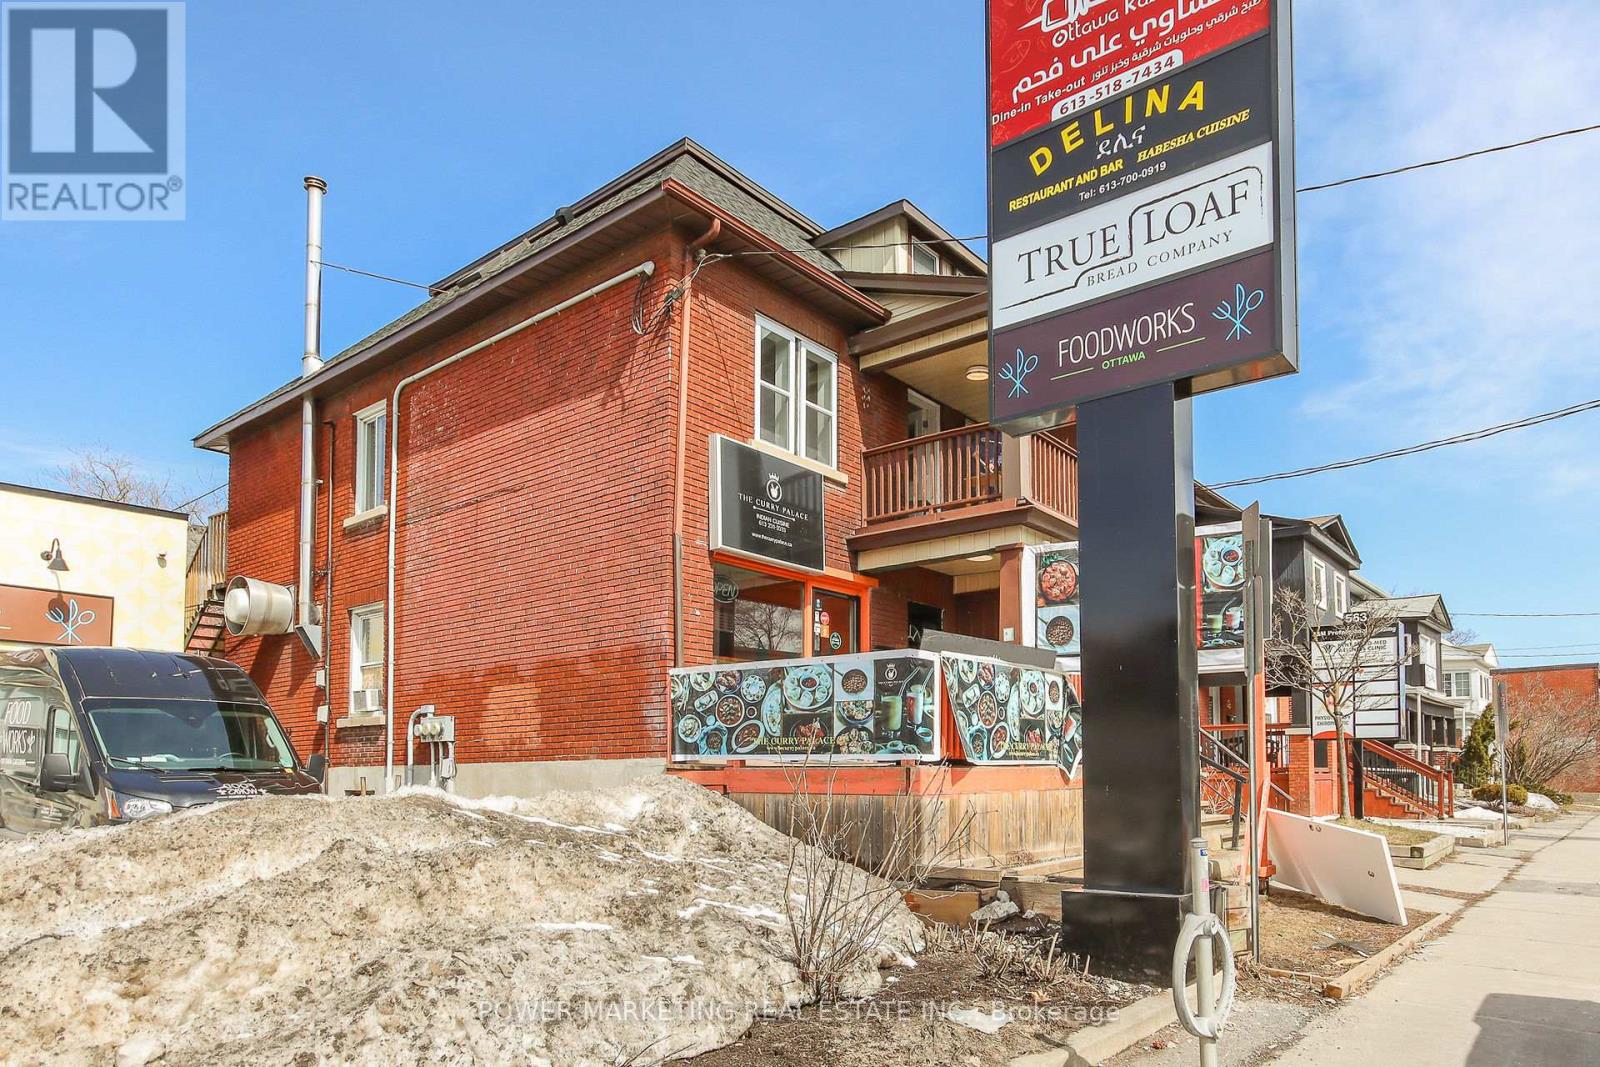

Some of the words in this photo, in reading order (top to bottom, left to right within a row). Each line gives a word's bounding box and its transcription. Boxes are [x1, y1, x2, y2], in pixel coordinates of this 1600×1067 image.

[1052, 8, 1119, 48] Ottawa
[1070, 33, 1122, 68] على
[1012, 56, 1064, 103] فحم
[991, 102, 1032, 126] Dine-in
[1034, 76, 1086, 105] Take-out
[1029, 80, 1206, 176] DELINA
[1008, 177, 1074, 213] RESTAURANT
[1075, 168, 1098, 187] AND
[1099, 158, 1124, 177] BAR
[1136, 132, 1196, 163] HABESHA
[1078, 188, 1096, 202] Tel:
[1098, 161, 1167, 195] 613-700-0919
[1017, 223, 1121, 284] TRUE
[1142, 179, 1249, 246] LOAF
[1086, 261, 1139, 287] BREAD
[1147, 229, 1233, 268] COMPANY
[1057, 302, 1197, 368] FOODWORKS
[1101, 350, 1146, 371] OTTAWA
[738, 492, 753, 504] THE
[755, 498, 780, 512] CURRY
[782, 506, 808, 521] PALACE
[714, 580, 736, 597] PEN
[4, 700, 32, 724] FOOD
[770, 736, 801, 745] CURRY
